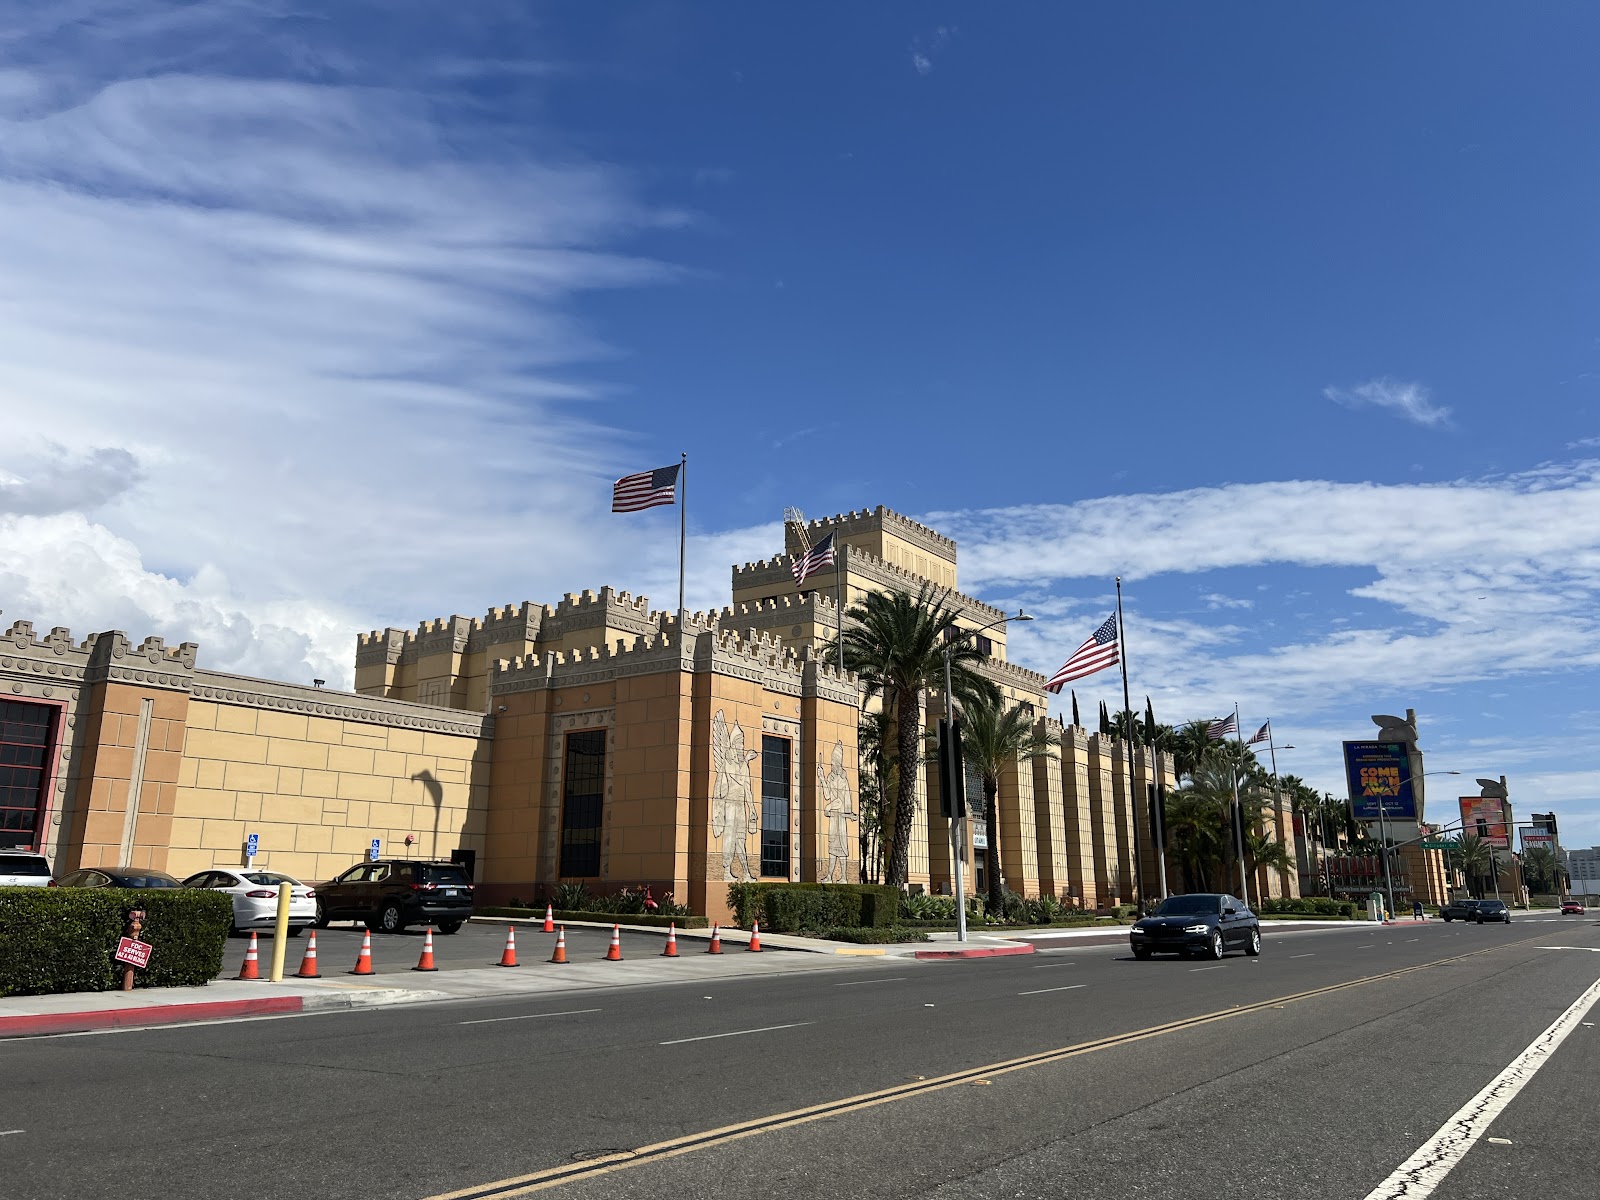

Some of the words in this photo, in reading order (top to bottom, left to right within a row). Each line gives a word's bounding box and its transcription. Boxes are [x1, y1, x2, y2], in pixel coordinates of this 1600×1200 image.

[1360, 767, 1399, 777] COME
[1361, 777, 1400, 787] FROM
[1362, 786, 1400, 796] AWAY
[123, 947, 145, 958] SERVES
